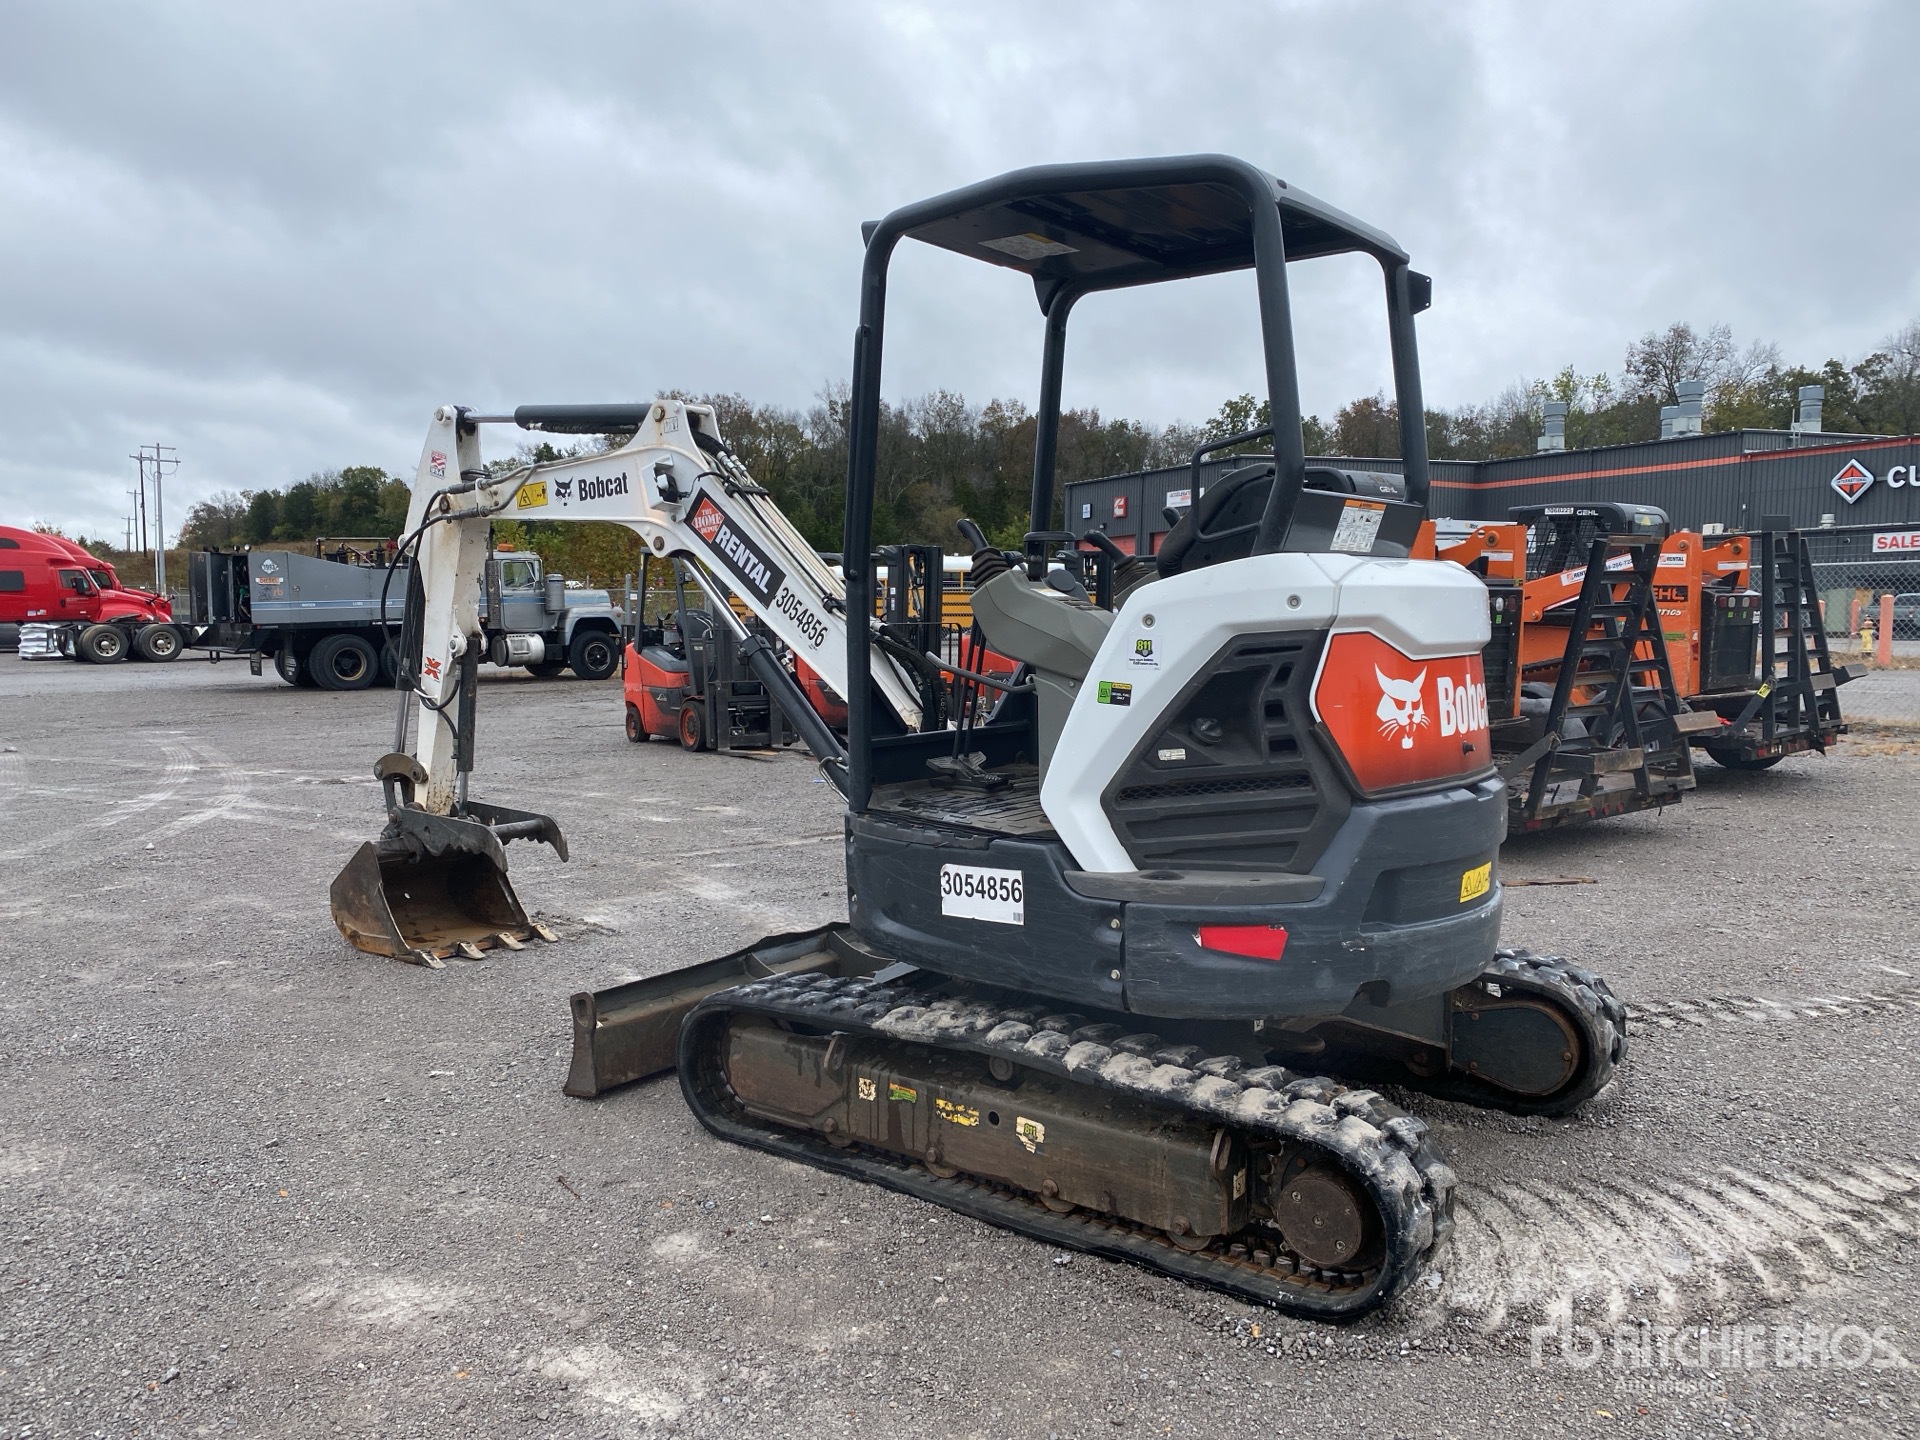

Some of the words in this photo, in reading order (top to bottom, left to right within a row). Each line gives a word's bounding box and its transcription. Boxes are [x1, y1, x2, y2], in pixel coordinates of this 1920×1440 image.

[578, 472, 629, 501] Bobcat
[694, 513, 721, 529] HOME
[714, 524, 772, 595] RENTAL
[776, 587, 829, 647] 3054856
[1137, 640, 1151, 651] 811
[942, 870, 1023, 903] 3054856
[1024, 1124, 1036, 1137] 811
